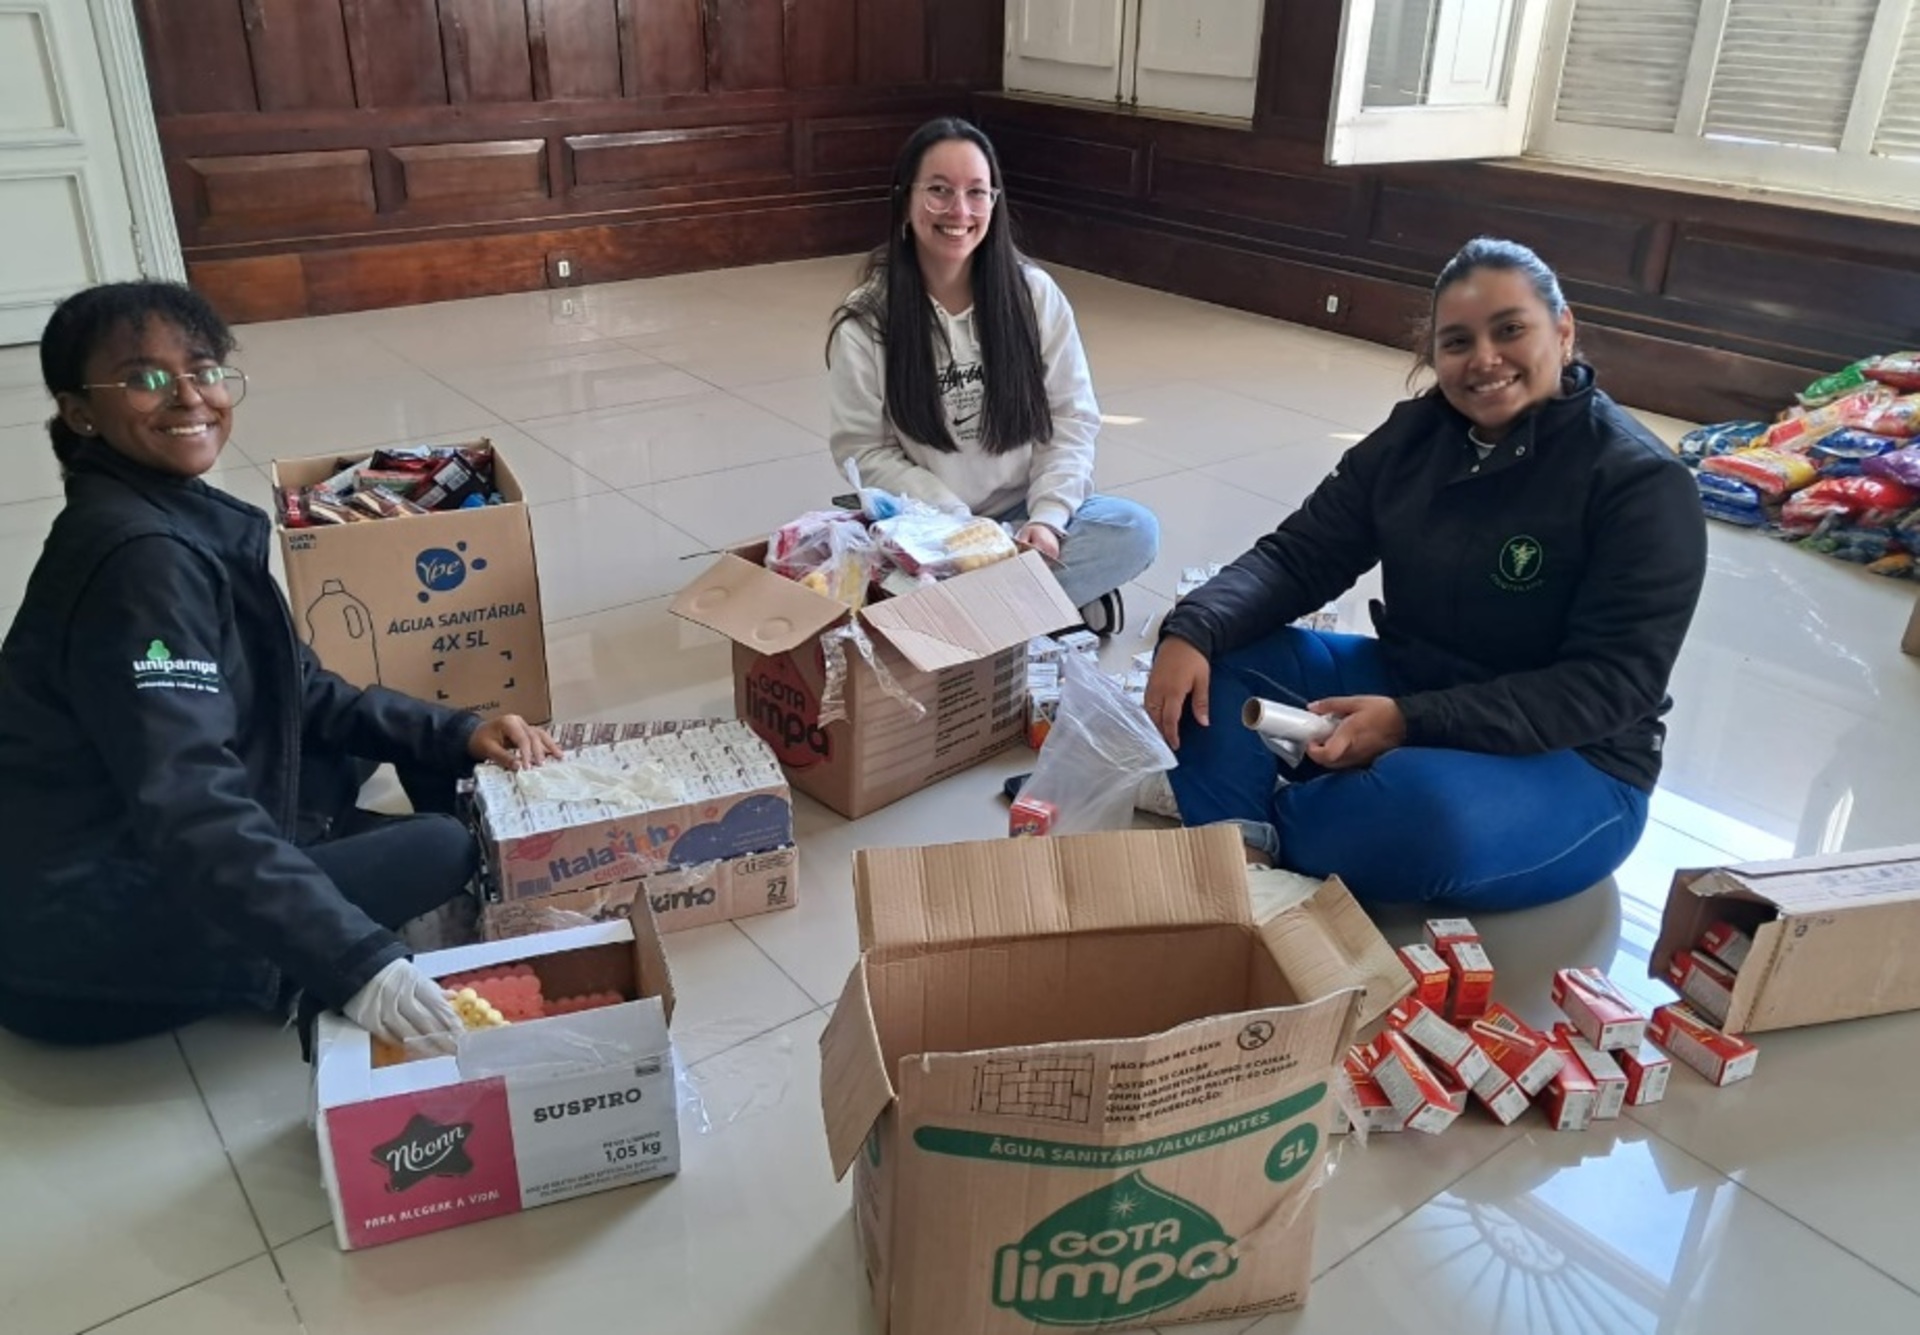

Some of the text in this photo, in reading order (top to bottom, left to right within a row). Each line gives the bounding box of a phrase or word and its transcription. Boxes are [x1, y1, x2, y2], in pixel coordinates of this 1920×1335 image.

[387, 602, 527, 635] ÁGUA SANITÁRIA
[432, 629, 489, 652] 4X 5L
[133, 657, 218, 675] unipampa
[759, 673, 806, 712] GOTA
[745, 676, 829, 757] limpa
[766, 880, 788, 899] 27
[533, 1087, 642, 1123] SUSPIRO
[386, 1126, 465, 1172] Nbonn
[605, 1140, 662, 1164] 1,05 kg
[989, 1137, 1046, 1157] ÁGUA
[1278, 1139, 1311, 1169] 5L
[364, 1213, 396, 1230] PARA
[400, 1200, 453, 1222] ALEGRAR
[457, 1197, 465, 1208] A
[1049, 1217, 1182, 1258] GOTA
[1000, 1241, 1238, 1305] limpa
